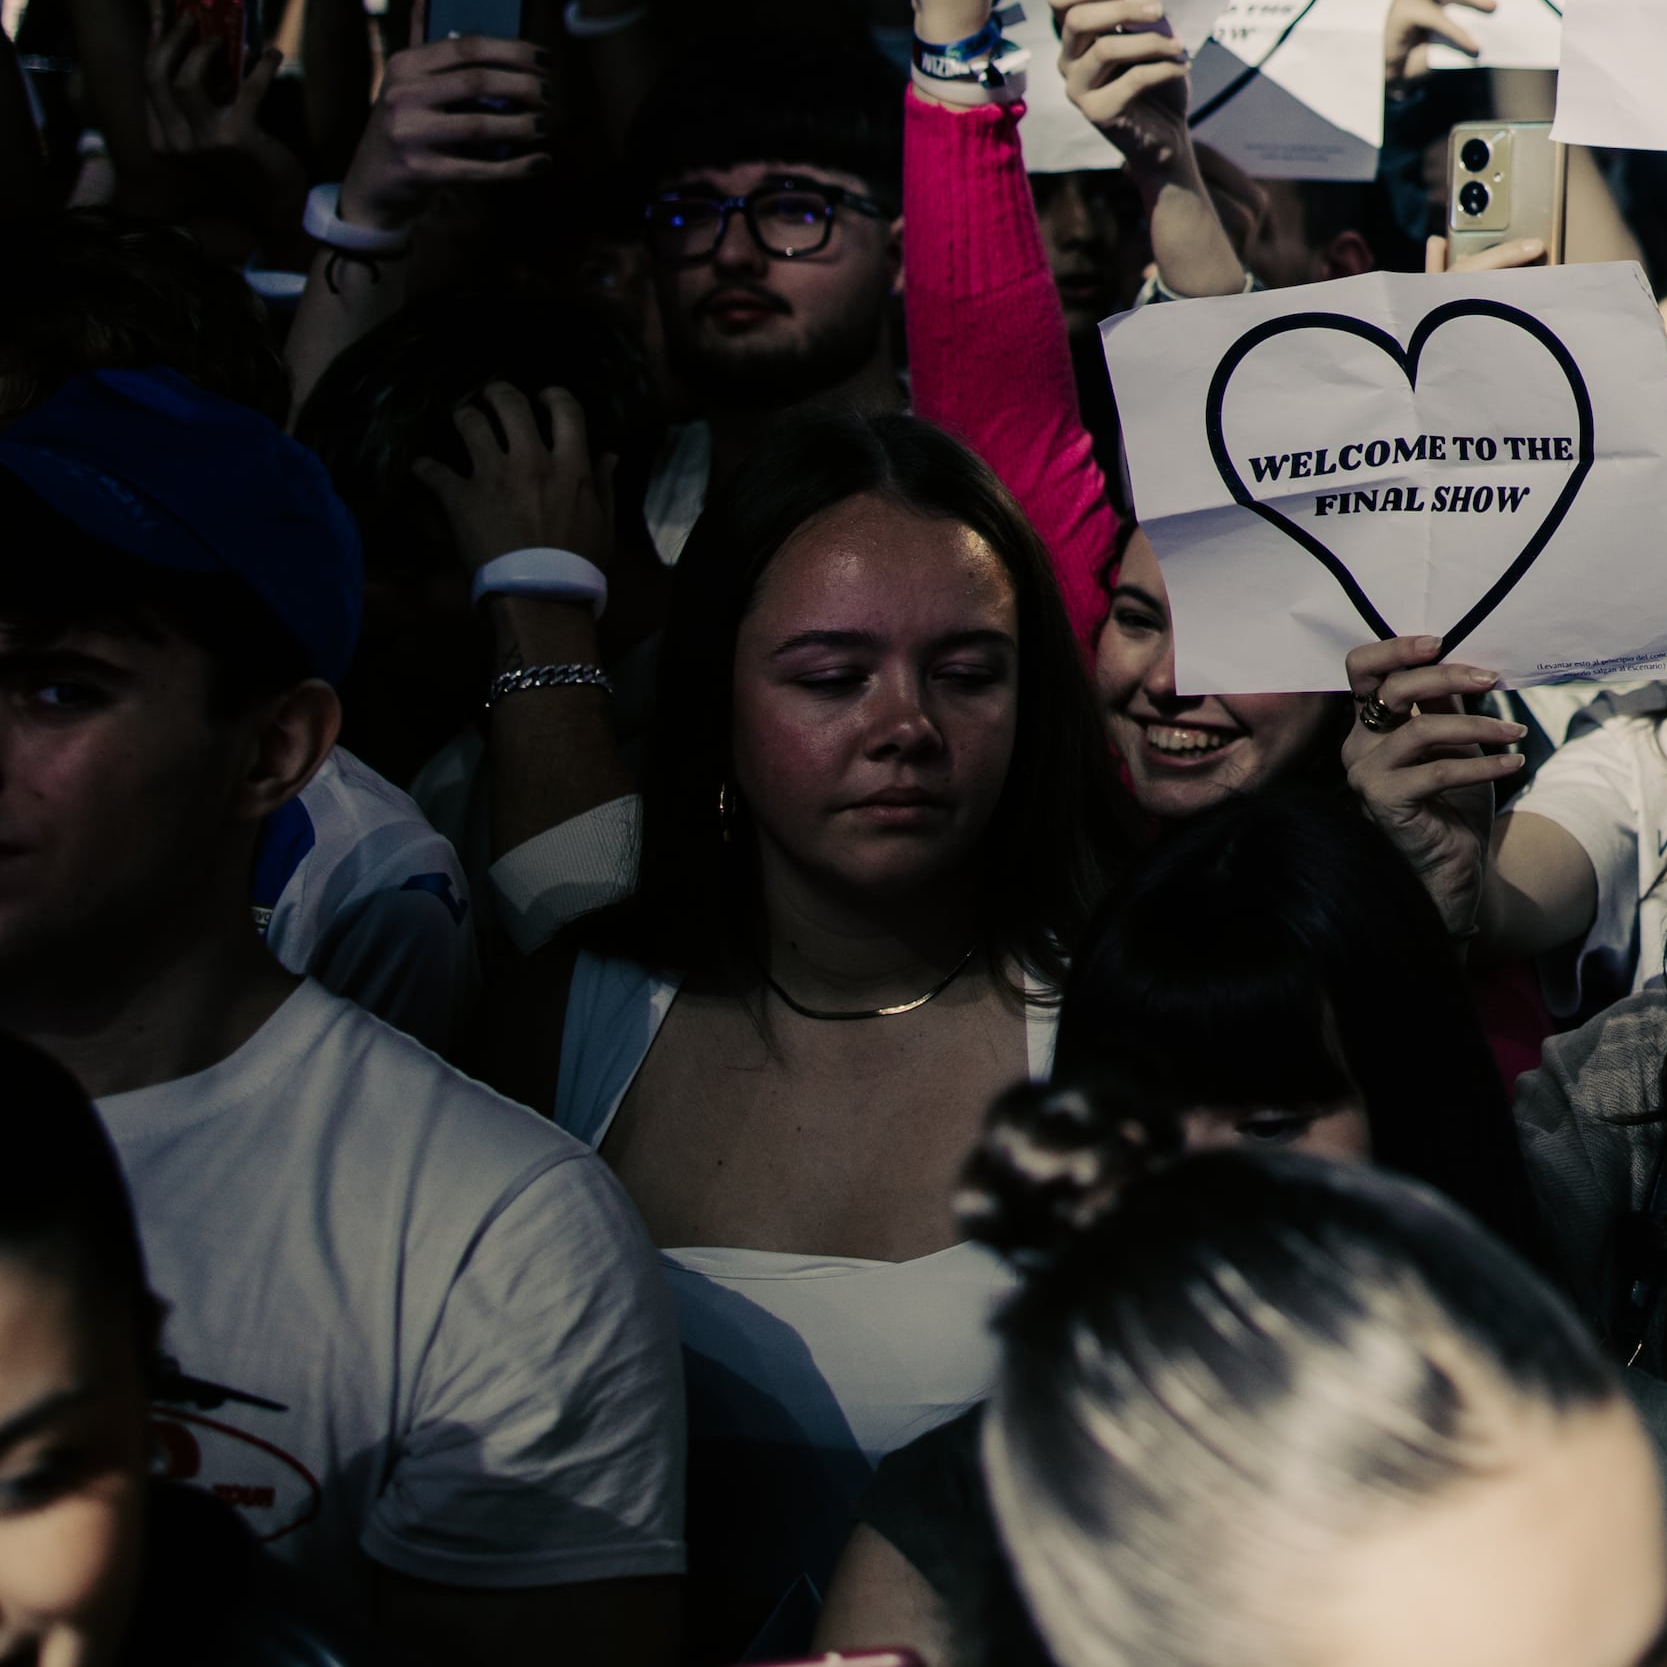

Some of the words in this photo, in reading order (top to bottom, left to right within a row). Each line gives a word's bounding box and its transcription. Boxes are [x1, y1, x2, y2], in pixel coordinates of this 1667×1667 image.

[1249, 434, 1446, 483] WELCOME
[1452, 436, 1497, 461] TO
[1503, 437, 1574, 461] THE
[1314, 488, 1424, 516] FINAL
[1430, 485, 1530, 514] SHOW
[1536, 661, 1572, 670] (Levantar
[1592, 658, 1600, 666] al
[1600, 656, 1634, 666] principio
[1636, 653, 1648, 661] del
[1593, 667, 1617, 677] salgan
